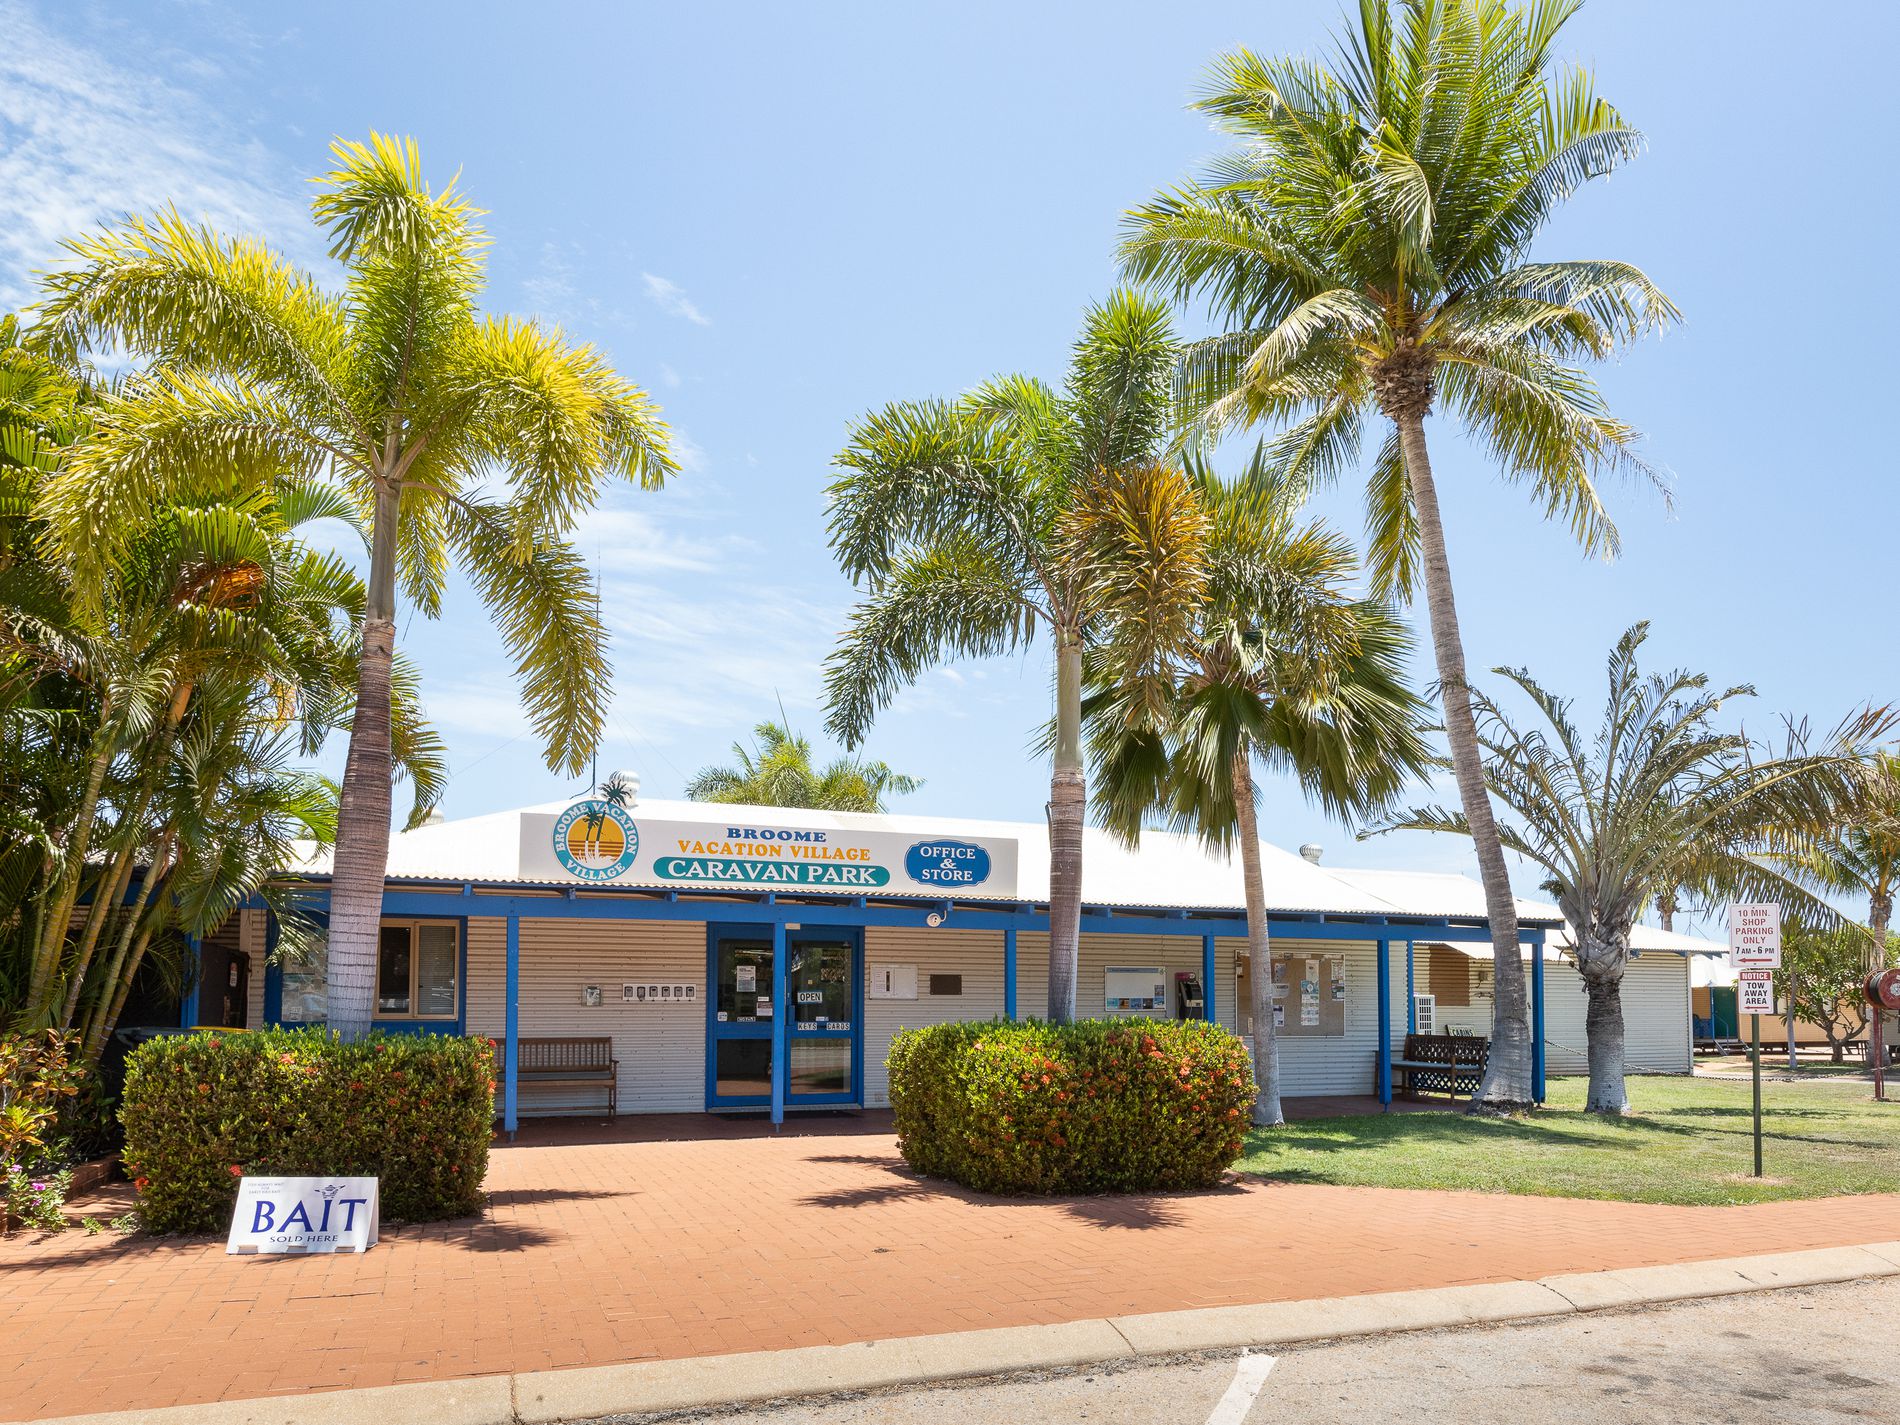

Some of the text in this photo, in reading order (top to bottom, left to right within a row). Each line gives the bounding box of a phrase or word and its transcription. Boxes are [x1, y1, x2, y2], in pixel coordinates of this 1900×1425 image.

[555, 802, 637, 854] BROOME VACATION
[726, 828, 827, 842] BROOME
[678, 840, 870, 861] VACATION VILLAGE
[920, 846, 976, 859] OFFICE
[940, 858, 957, 869] &
[566, 859, 626, 880] VILLAGE
[667, 860, 877, 884] CARAVAN PARK
[921, 868, 973, 881] STORE
[1738, 909, 1771, 917] 10 MIN.
[1742, 918, 1766, 926] SHOP
[1735, 927, 1774, 935] PARKING
[1743, 936, 1766, 944] ONLY
[1735, 946, 1740, 955] 7
[1757, 946, 1763, 955] 6
[1765, 947, 1775, 955] PM
[1742, 972, 1768, 980] NOTICE
[800, 992, 820, 1001] OPEN
[250, 1199, 367, 1233] BAIT
[269, 1235, 303, 1243] SOLD
